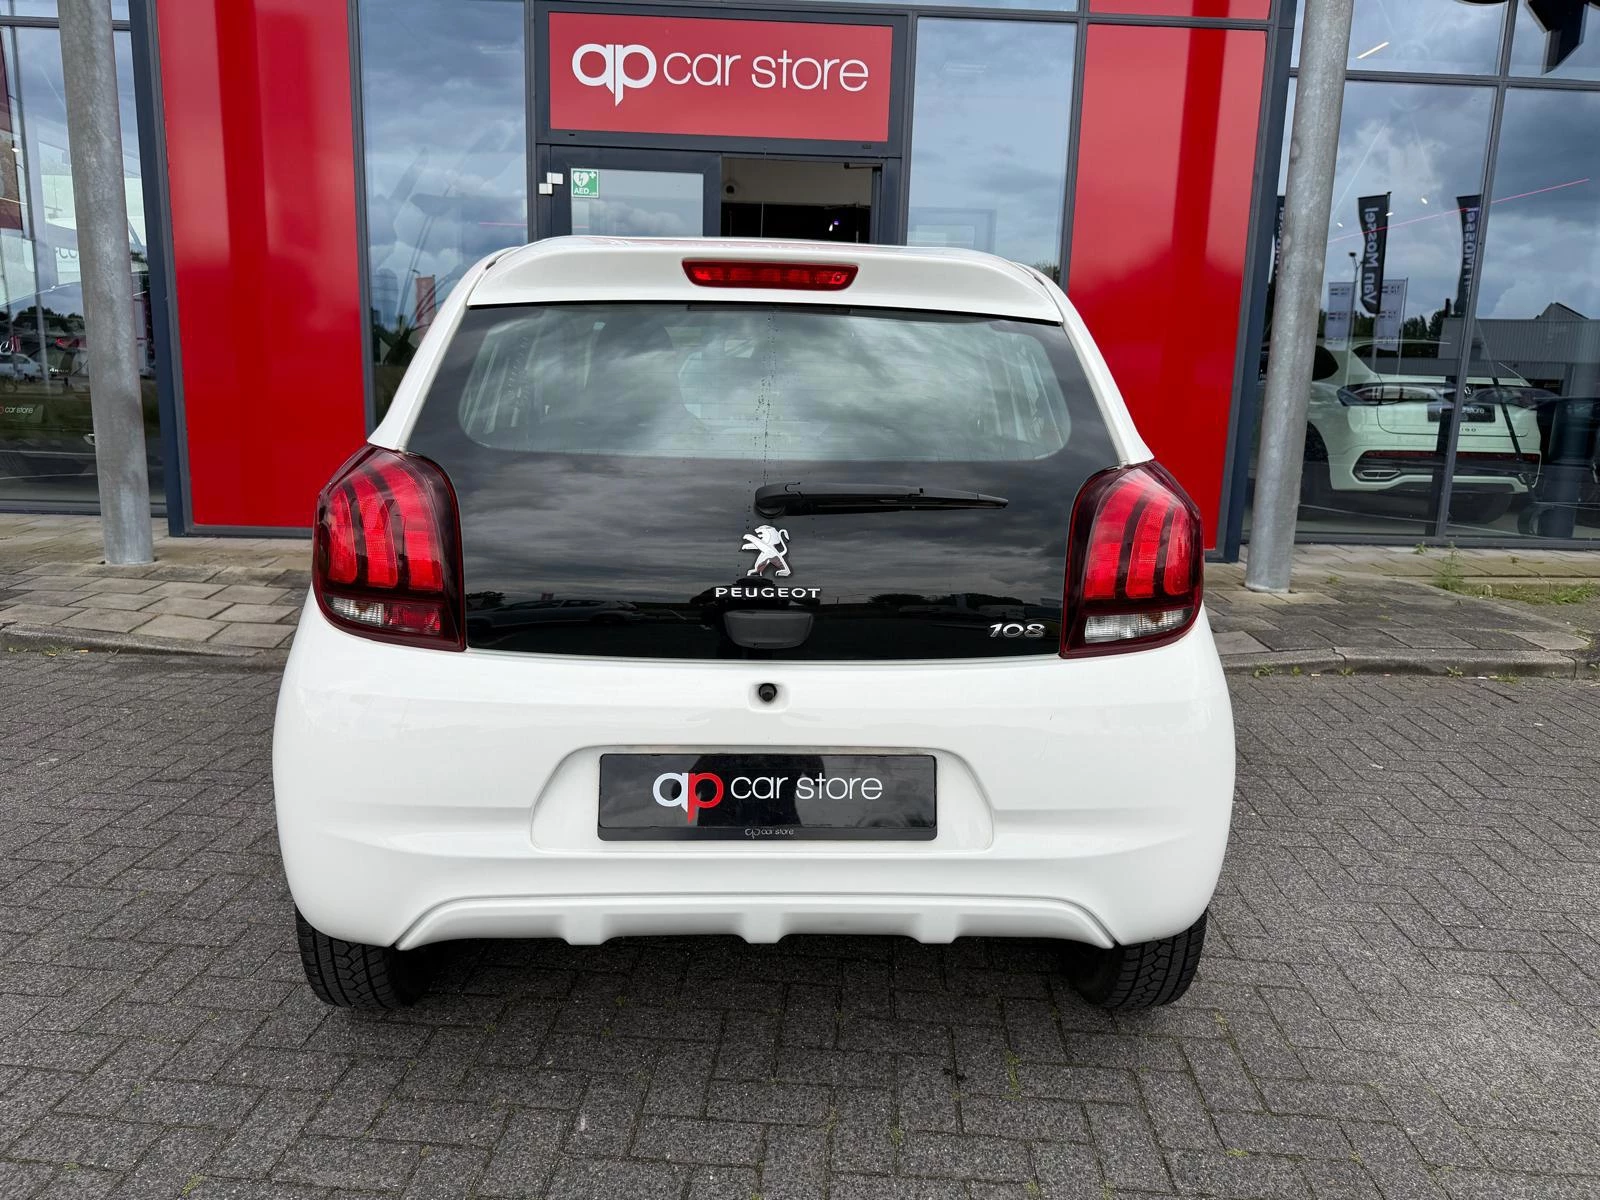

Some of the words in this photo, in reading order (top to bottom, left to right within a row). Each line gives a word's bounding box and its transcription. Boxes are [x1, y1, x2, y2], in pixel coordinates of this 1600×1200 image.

[663, 52, 741, 86] car
[751, 50, 869, 92] store
[574, 187, 590, 195] AED
[715, 587, 821, 598] PEUGEOT
[990, 623, 1045, 638] 108
[730, 776, 789, 799] car
[795, 772, 883, 800] store
